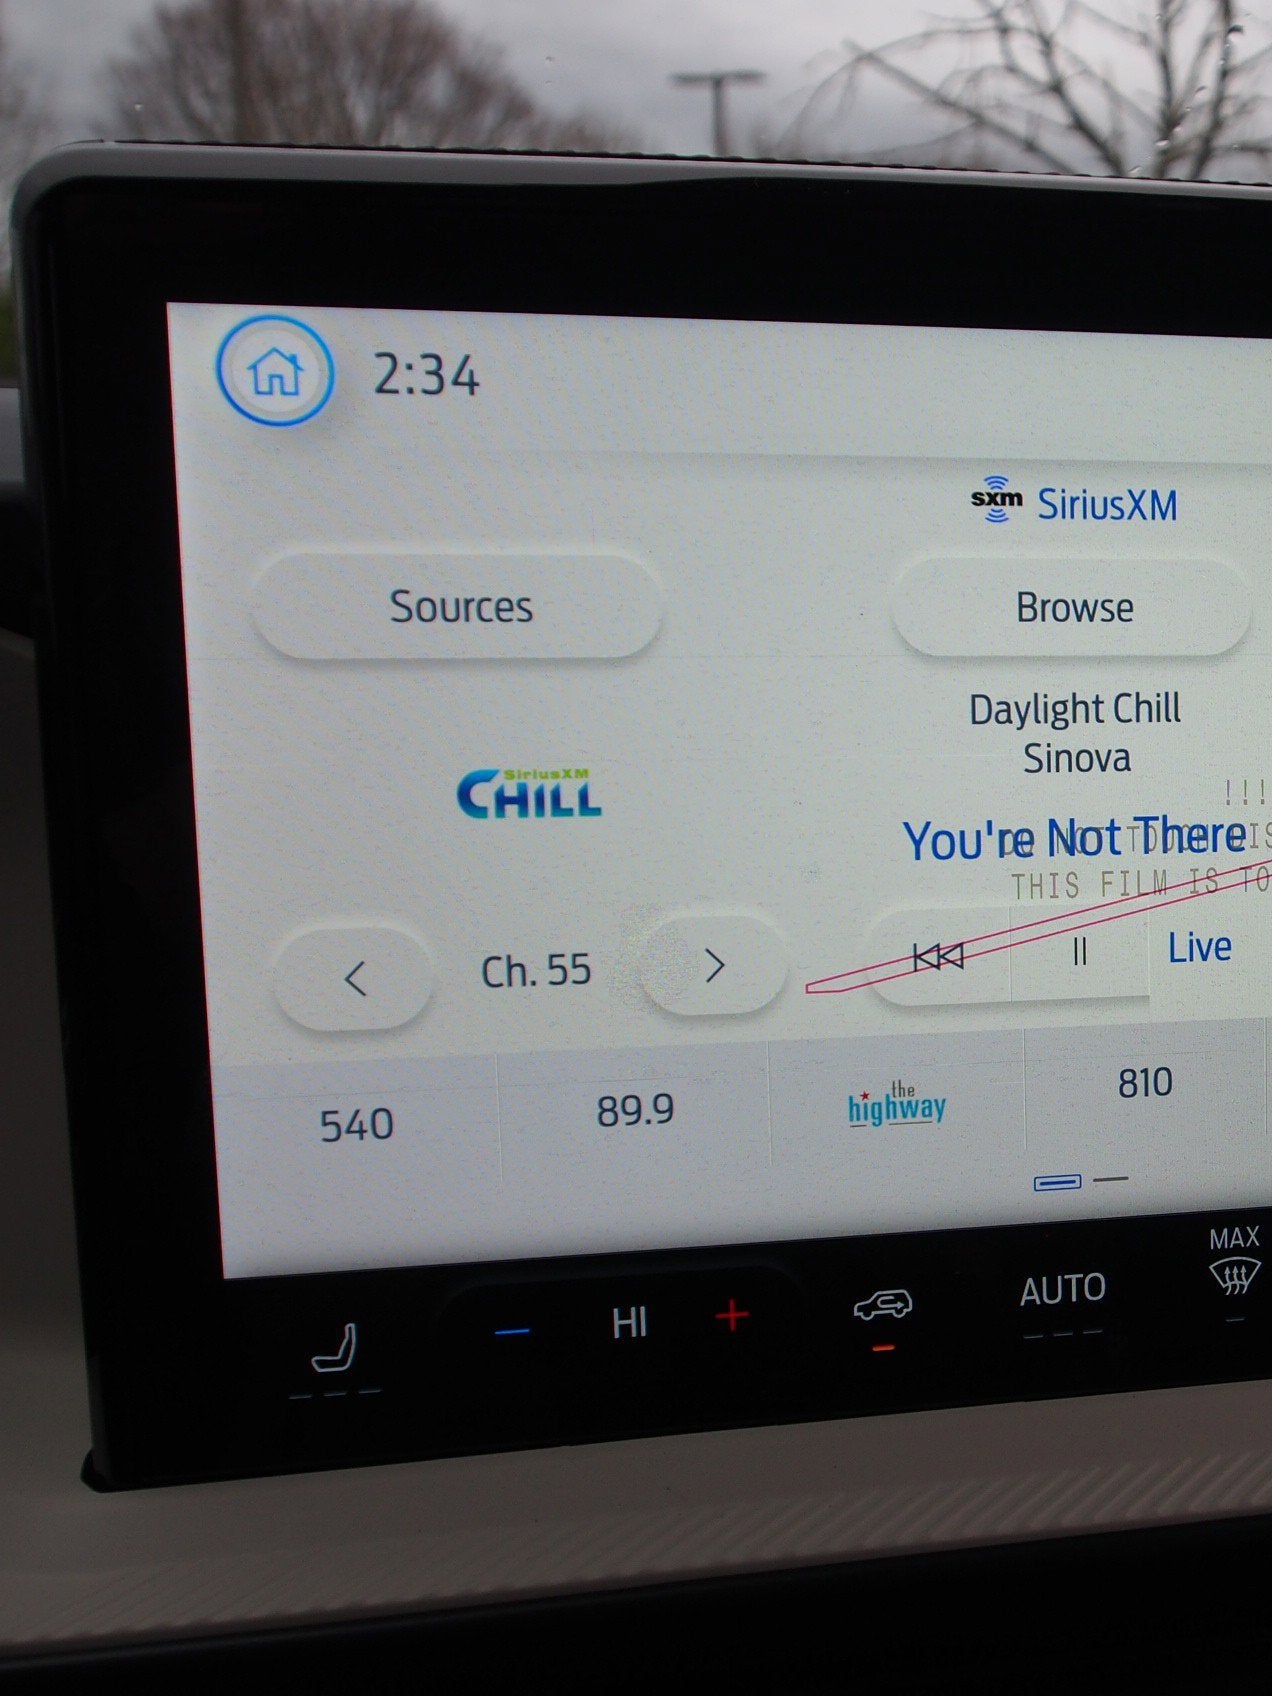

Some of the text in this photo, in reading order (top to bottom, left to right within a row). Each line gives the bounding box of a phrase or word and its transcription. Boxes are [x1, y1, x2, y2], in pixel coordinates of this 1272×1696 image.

[374, 351, 480, 396] 2:34
[1038, 488, 1177, 521] SiriusXM
[390, 588, 534, 624] Sources
[1017, 591, 1134, 622] Browse
[970, 691, 1182, 731] Daylight Chill
[503, 768, 591, 781] SiriusXM
[1024, 743, 1132, 774] Sinova
[902, 814, 1247, 861] You're Not There
[1011, 871, 1080, 900] THIS
[1101, 869, 1167, 898] FILM
[1190, 867, 1219, 894] IS
[1239, 865, 1271, 892] TO
[1169, 931, 1233, 963] Live
[481, 953, 592, 989] Ch. 55
[892, 1079, 915, 1098] the
[1118, 1066, 1174, 1099] 810
[320, 1107, 394, 1143] 540
[596, 1093, 675, 1128] 89.9
[848, 1093, 946, 1127] highway
[1209, 1225, 1261, 1250] MAX
[1020, 1272, 1107, 1307] AUTO
[612, 1305, 648, 1339] HI
